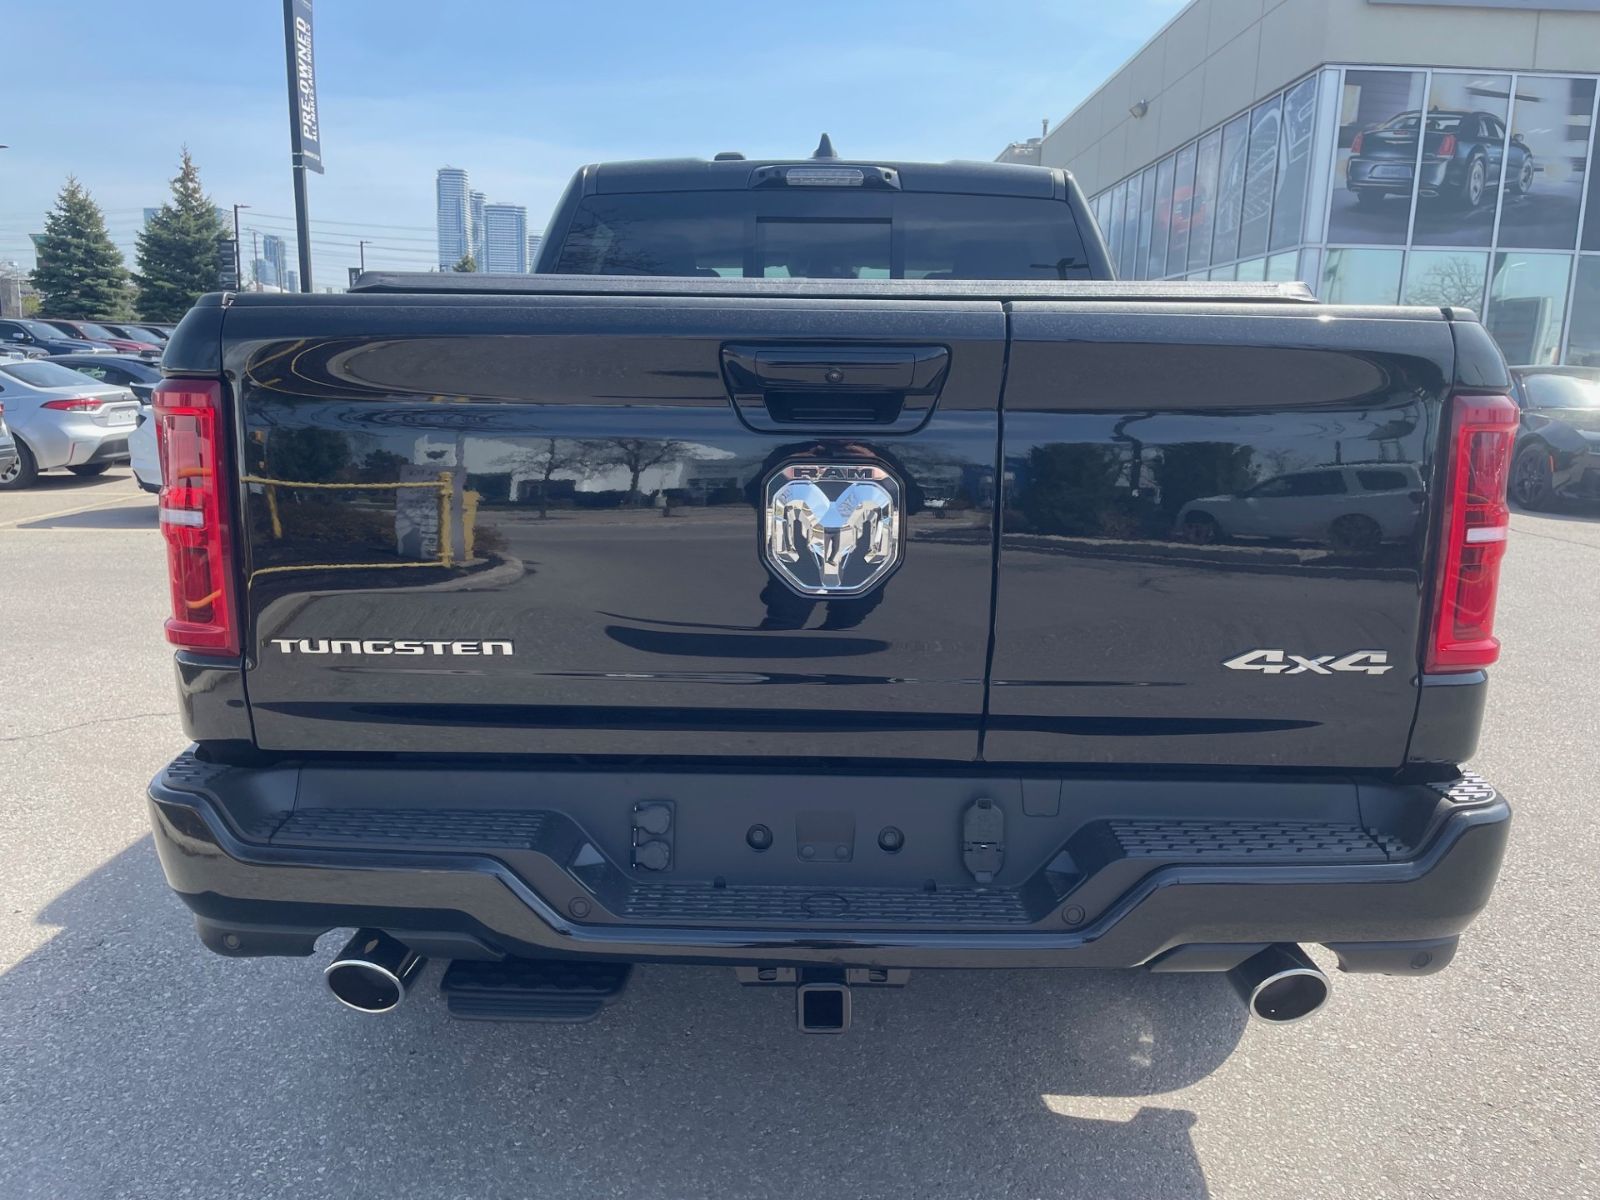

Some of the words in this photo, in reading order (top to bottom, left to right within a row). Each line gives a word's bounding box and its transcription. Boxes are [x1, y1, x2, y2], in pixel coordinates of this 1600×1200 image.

[296, 16, 313, 140] PRE-OWNED
[308, 88, 316, 122] MAKES
[793, 467, 873, 479] RAM
[271, 639, 514, 656] TUNGSTEN
